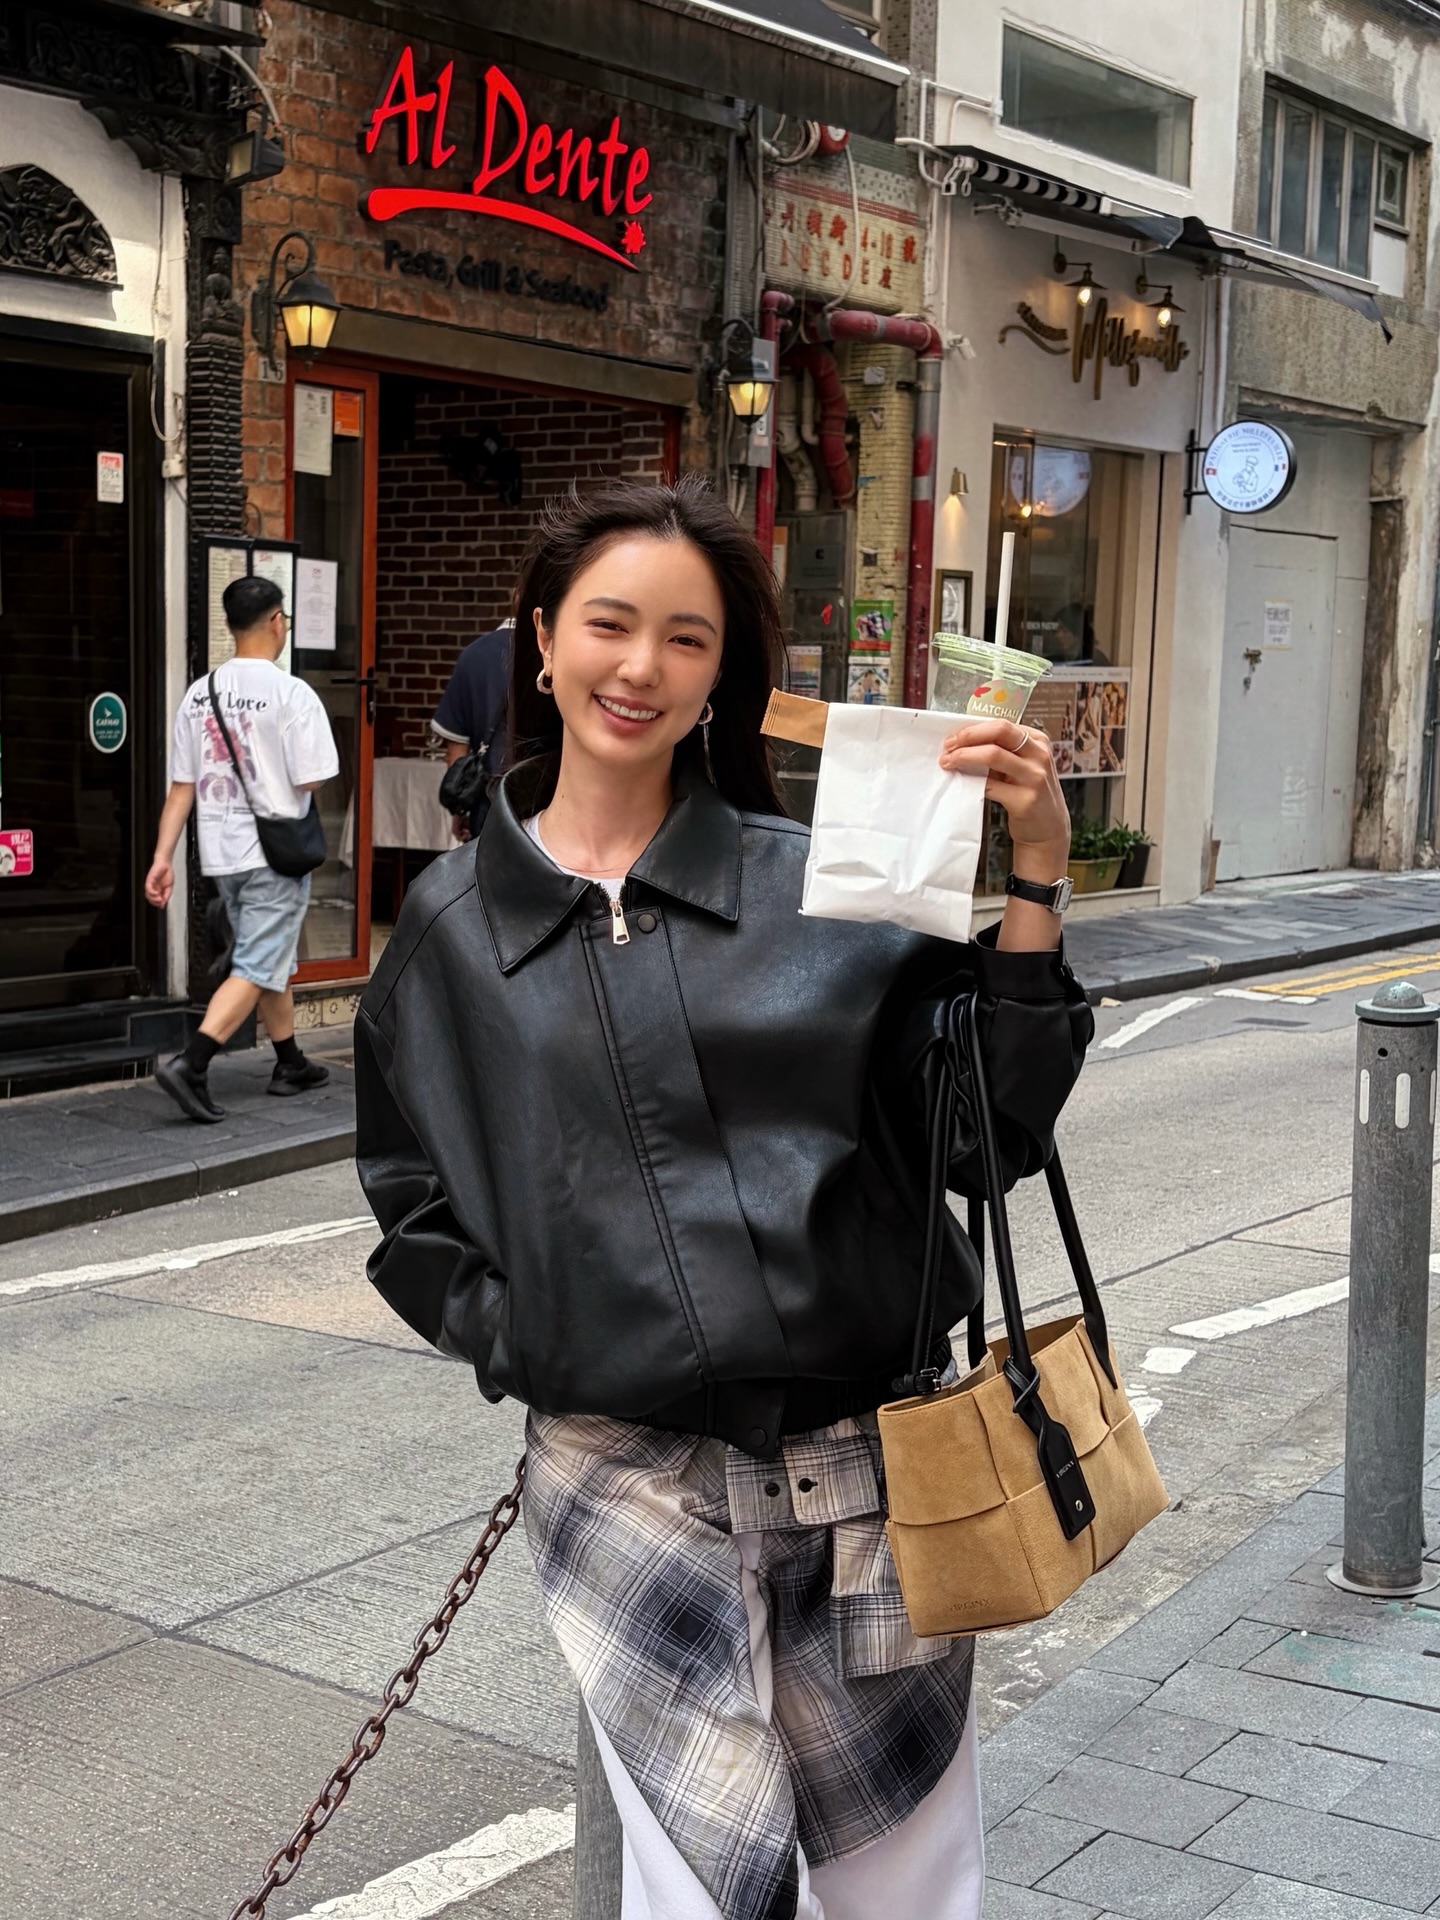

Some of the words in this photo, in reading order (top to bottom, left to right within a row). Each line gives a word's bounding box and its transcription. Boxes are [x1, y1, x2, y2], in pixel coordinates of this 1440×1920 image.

[367, 46, 456, 168] Al
[473, 65, 653, 215] Dente
[457, 255, 502, 290] Grill
[525, 269, 609, 312] Seafood
